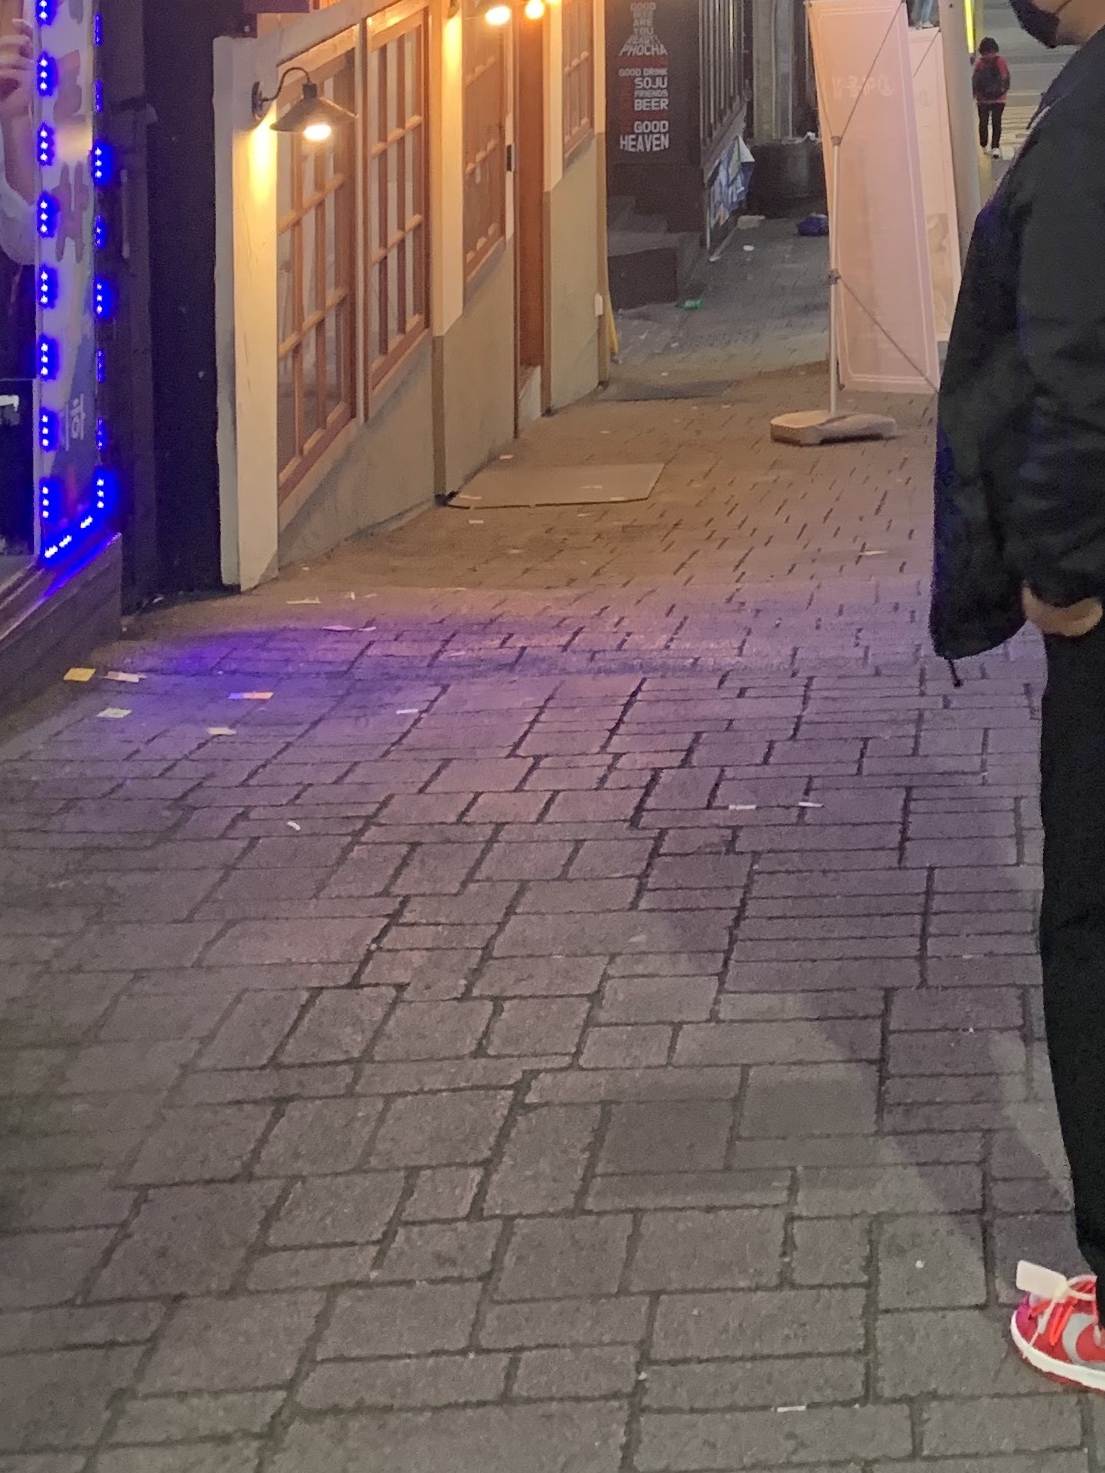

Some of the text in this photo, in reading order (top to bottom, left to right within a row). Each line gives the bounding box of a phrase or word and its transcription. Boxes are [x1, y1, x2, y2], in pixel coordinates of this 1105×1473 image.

[633, 27, 654, 35] YOU
[619, 44, 668, 56] PHOCHA
[619, 68, 641, 76] GOOD
[634, 76, 668, 89] SOJU
[633, 98, 669, 111] BEER
[634, 120, 669, 133] GOOD
[619, 134, 670, 153] HEAVEN
